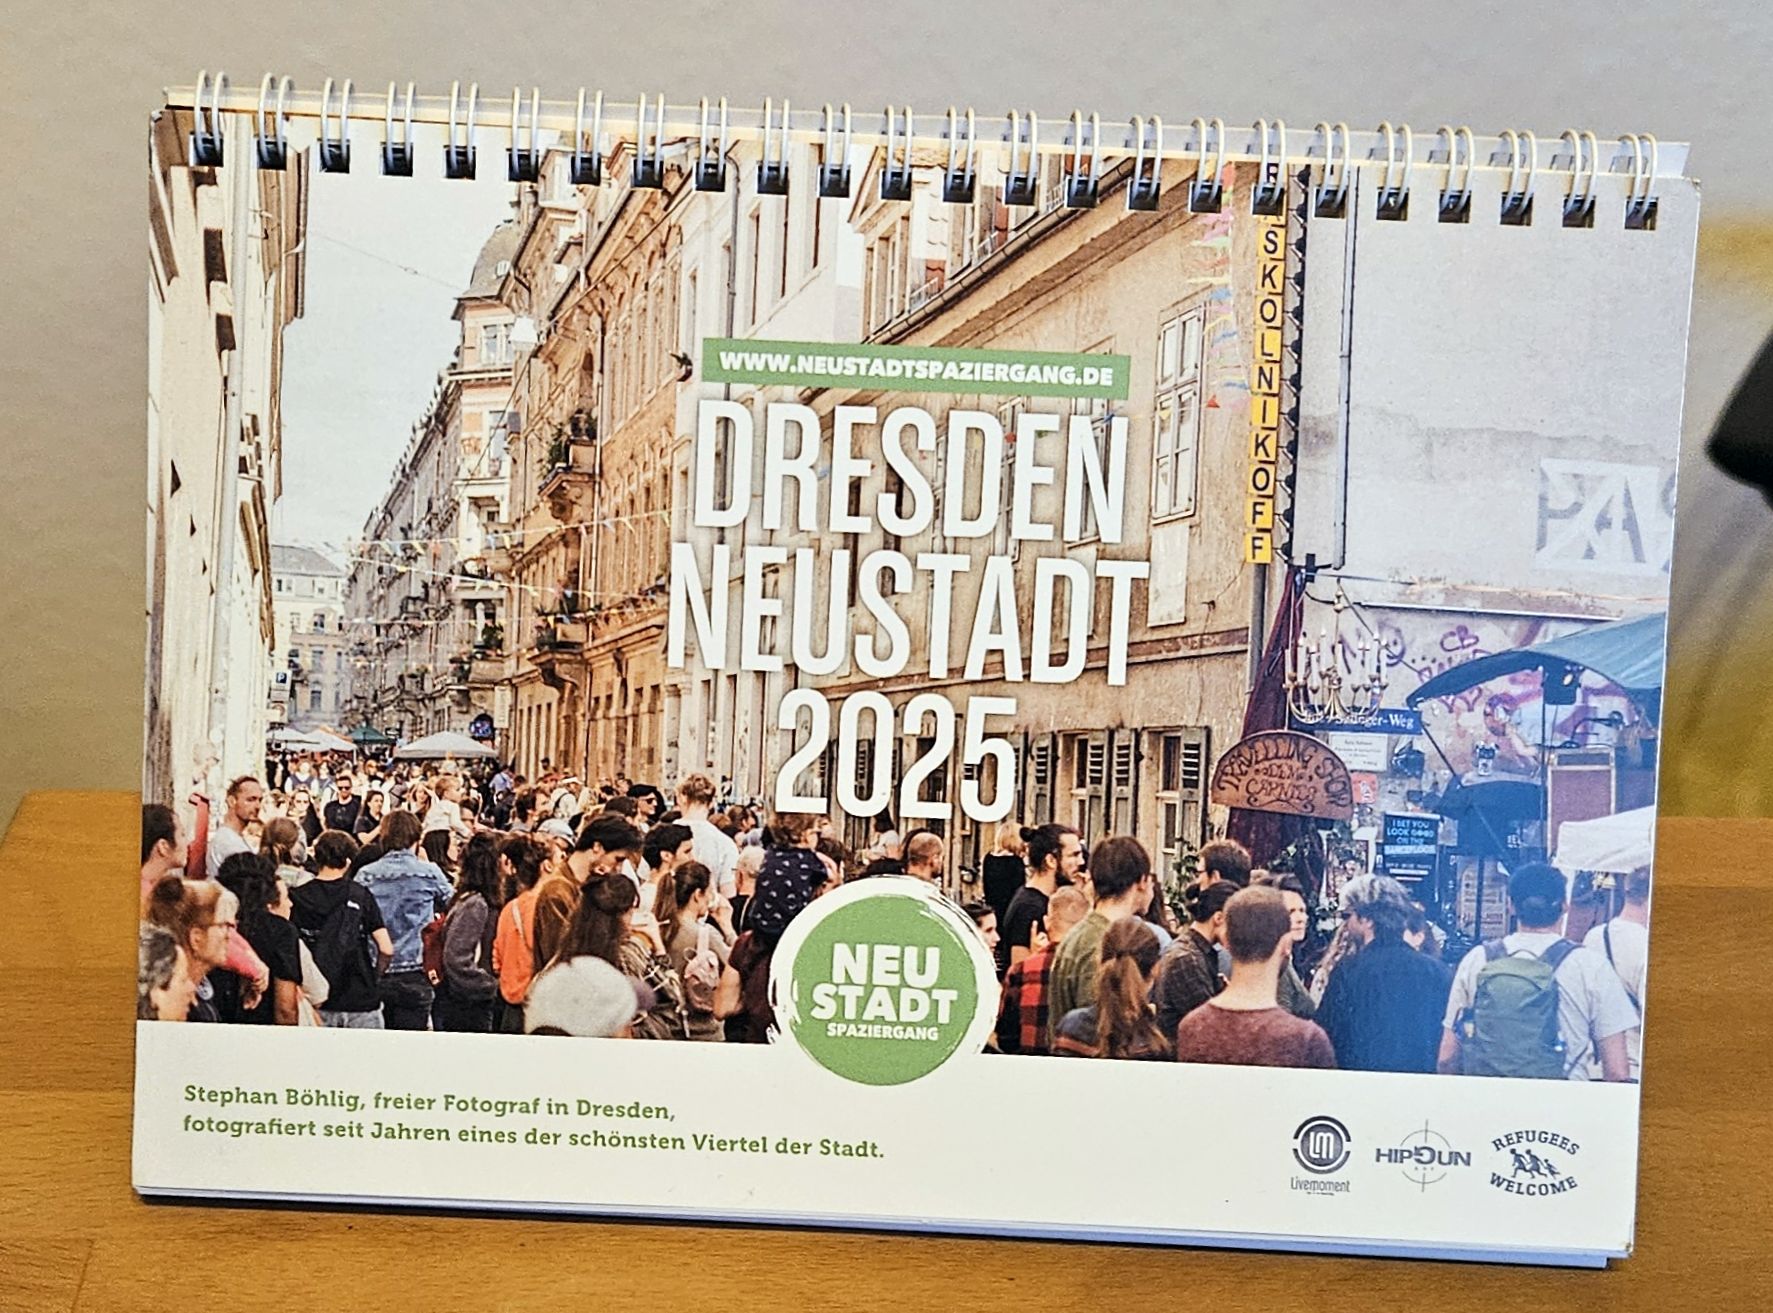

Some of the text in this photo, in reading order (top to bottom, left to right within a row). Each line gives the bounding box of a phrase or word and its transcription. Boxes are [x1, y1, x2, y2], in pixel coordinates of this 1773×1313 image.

[719, 351, 1113, 387] WWW.NEUSTADTSPAZIERGANG.DE
[1250, 163, 1281, 560] RSKOLNIKOFF
[694, 400, 1130, 544] DRESDEN
[667, 543, 1151, 687] NEUSTADT
[774, 688, 1018, 823] 2025
[1387, 827, 1410, 836] LOOK
[1412, 820, 1430, 829] YOU
[831, 943, 941, 989] NEU
[810, 983, 959, 1024] STADT
[826, 1022, 939, 1041] SPAZIERGANG
[184, 1085, 675, 1122] Stephan Böhlig, freier Fotograf in Dresden,
[183, 1115, 885, 1159] fotografiert seit Jahren eines der schönsten Viertel der Stadt.
[1491, 1129, 1581, 1156] REFUGEES
[1290, 1175, 1351, 1193] Livemoment
[1489, 1171, 1579, 1197] WELCOME
